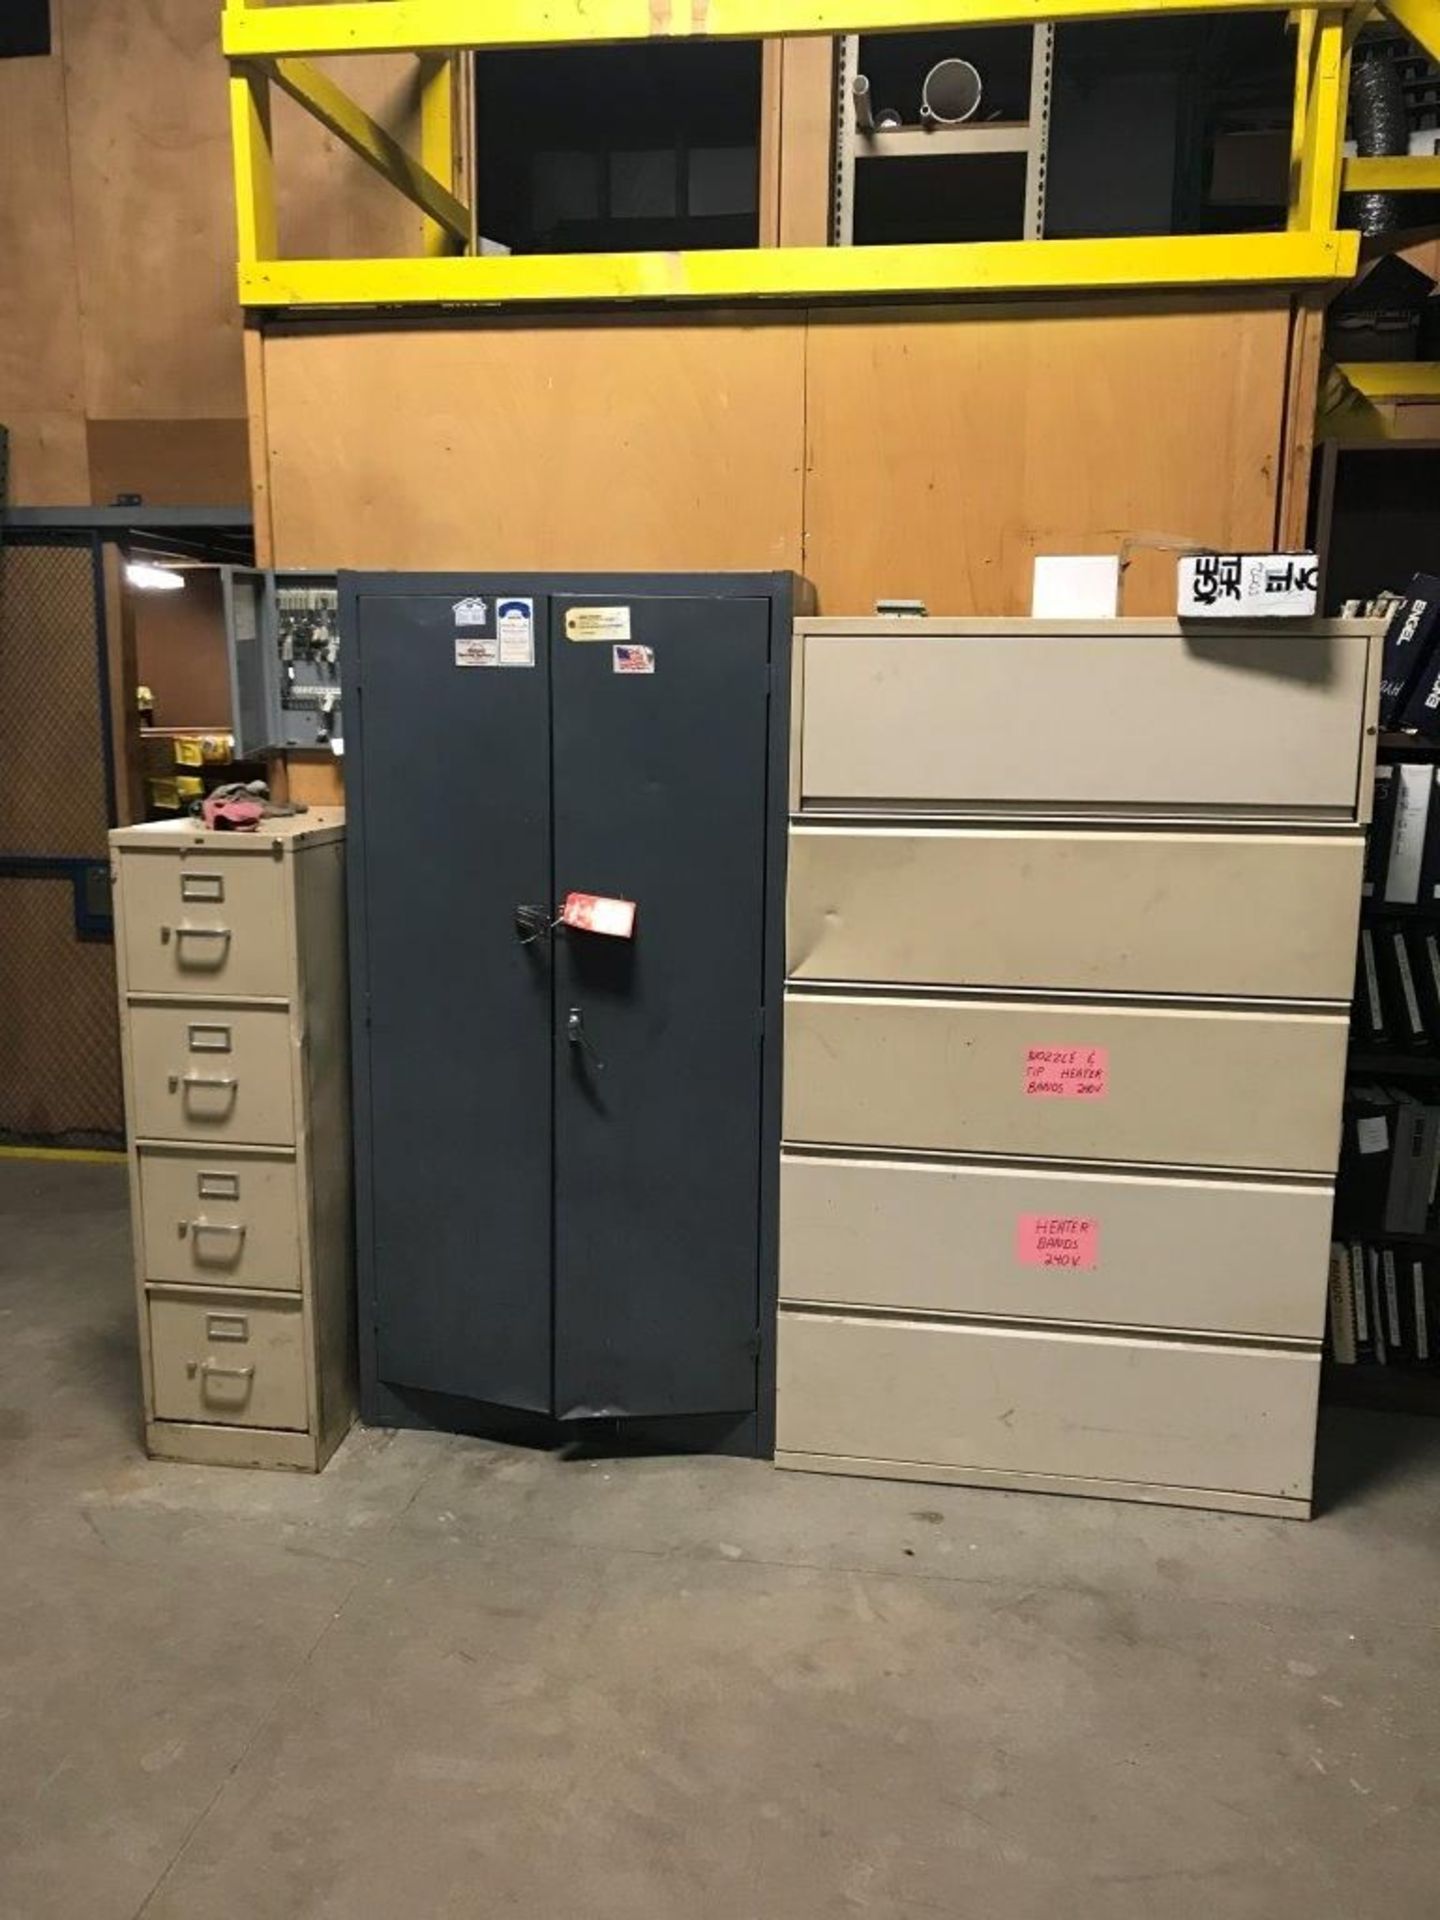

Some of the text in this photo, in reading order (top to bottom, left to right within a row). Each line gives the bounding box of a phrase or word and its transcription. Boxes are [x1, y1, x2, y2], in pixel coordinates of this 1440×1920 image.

[1396, 599, 1427, 646] ENGEL
[1027, 1066, 1103, 1079] TIP HEATER
[1027, 1081, 1064, 1094] BANDS
[1035, 1219, 1090, 1235] HEATER
[1036, 1236, 1079, 1250] BANDS
